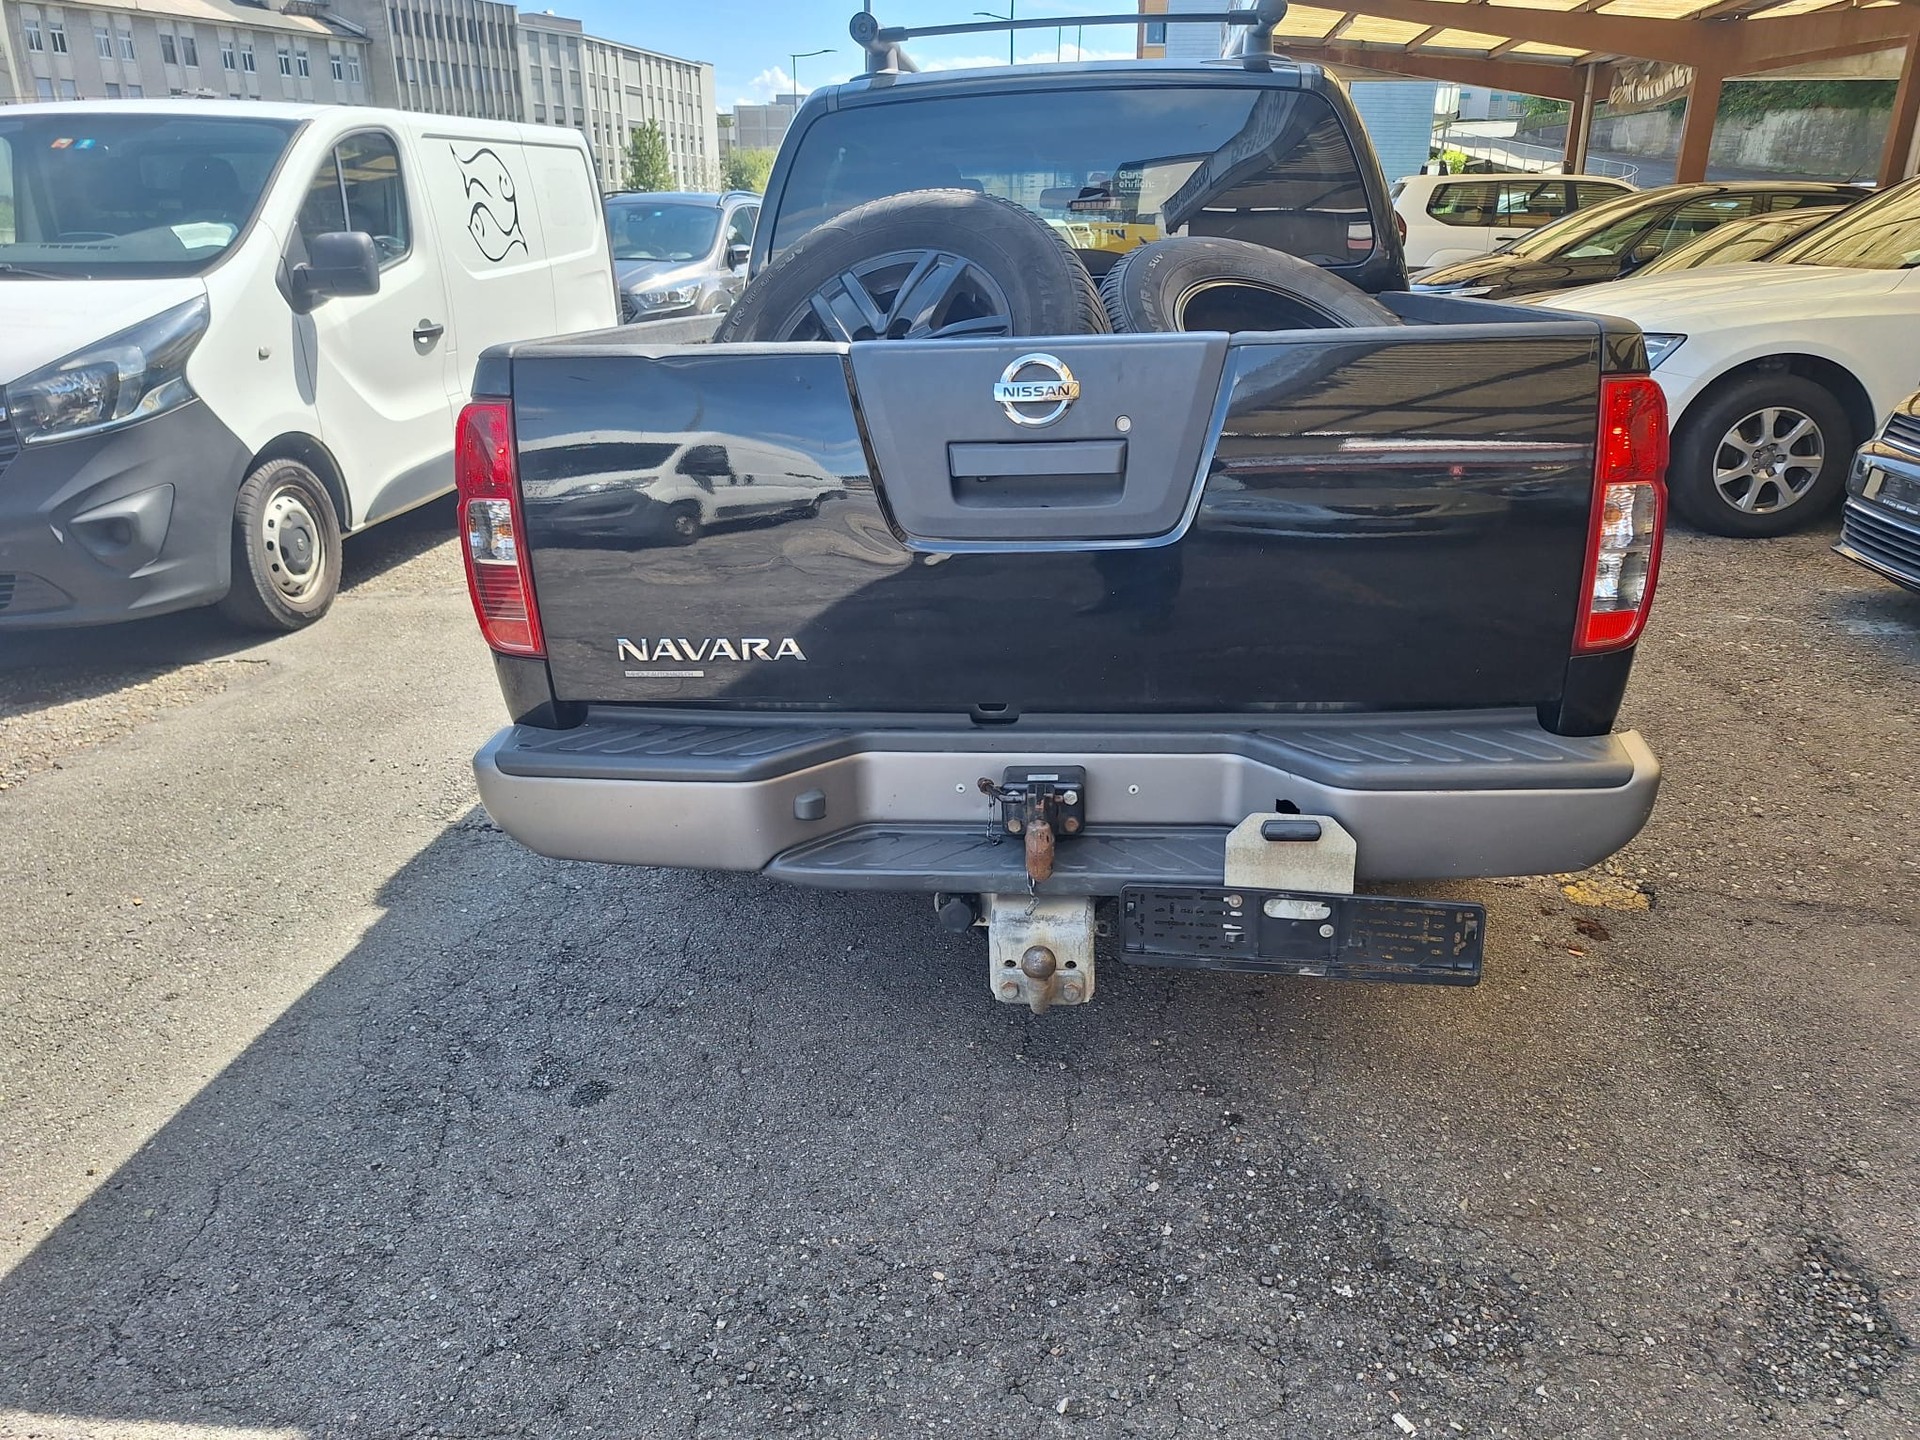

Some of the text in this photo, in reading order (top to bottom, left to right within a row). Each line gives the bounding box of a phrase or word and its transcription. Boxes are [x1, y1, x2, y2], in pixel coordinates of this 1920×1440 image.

[1148, 252, 1164, 269] SUV
[1003, 385, 1070, 397] NISSAN
[616, 638, 807, 662] NAVARA
